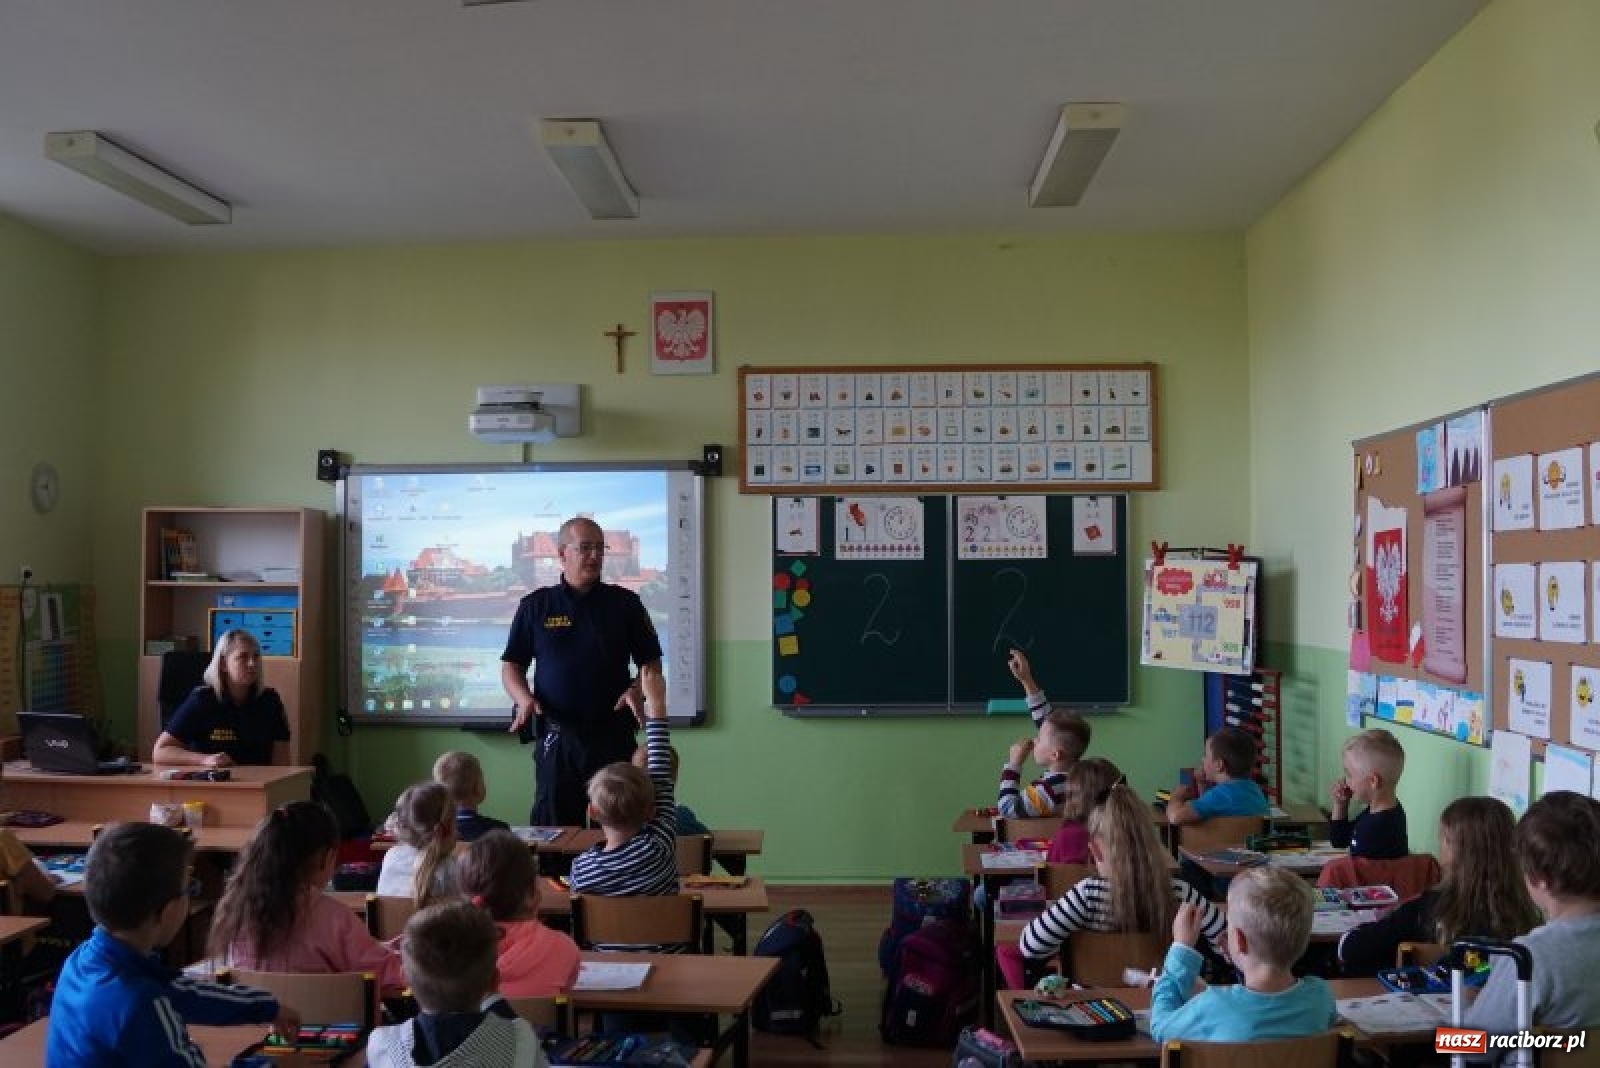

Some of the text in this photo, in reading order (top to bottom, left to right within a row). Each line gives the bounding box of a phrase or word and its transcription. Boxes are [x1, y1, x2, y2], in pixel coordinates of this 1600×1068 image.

[861, 572, 902, 645] 2
[993, 567, 1035, 653] 2
[1188, 612, 1215, 633] 112
